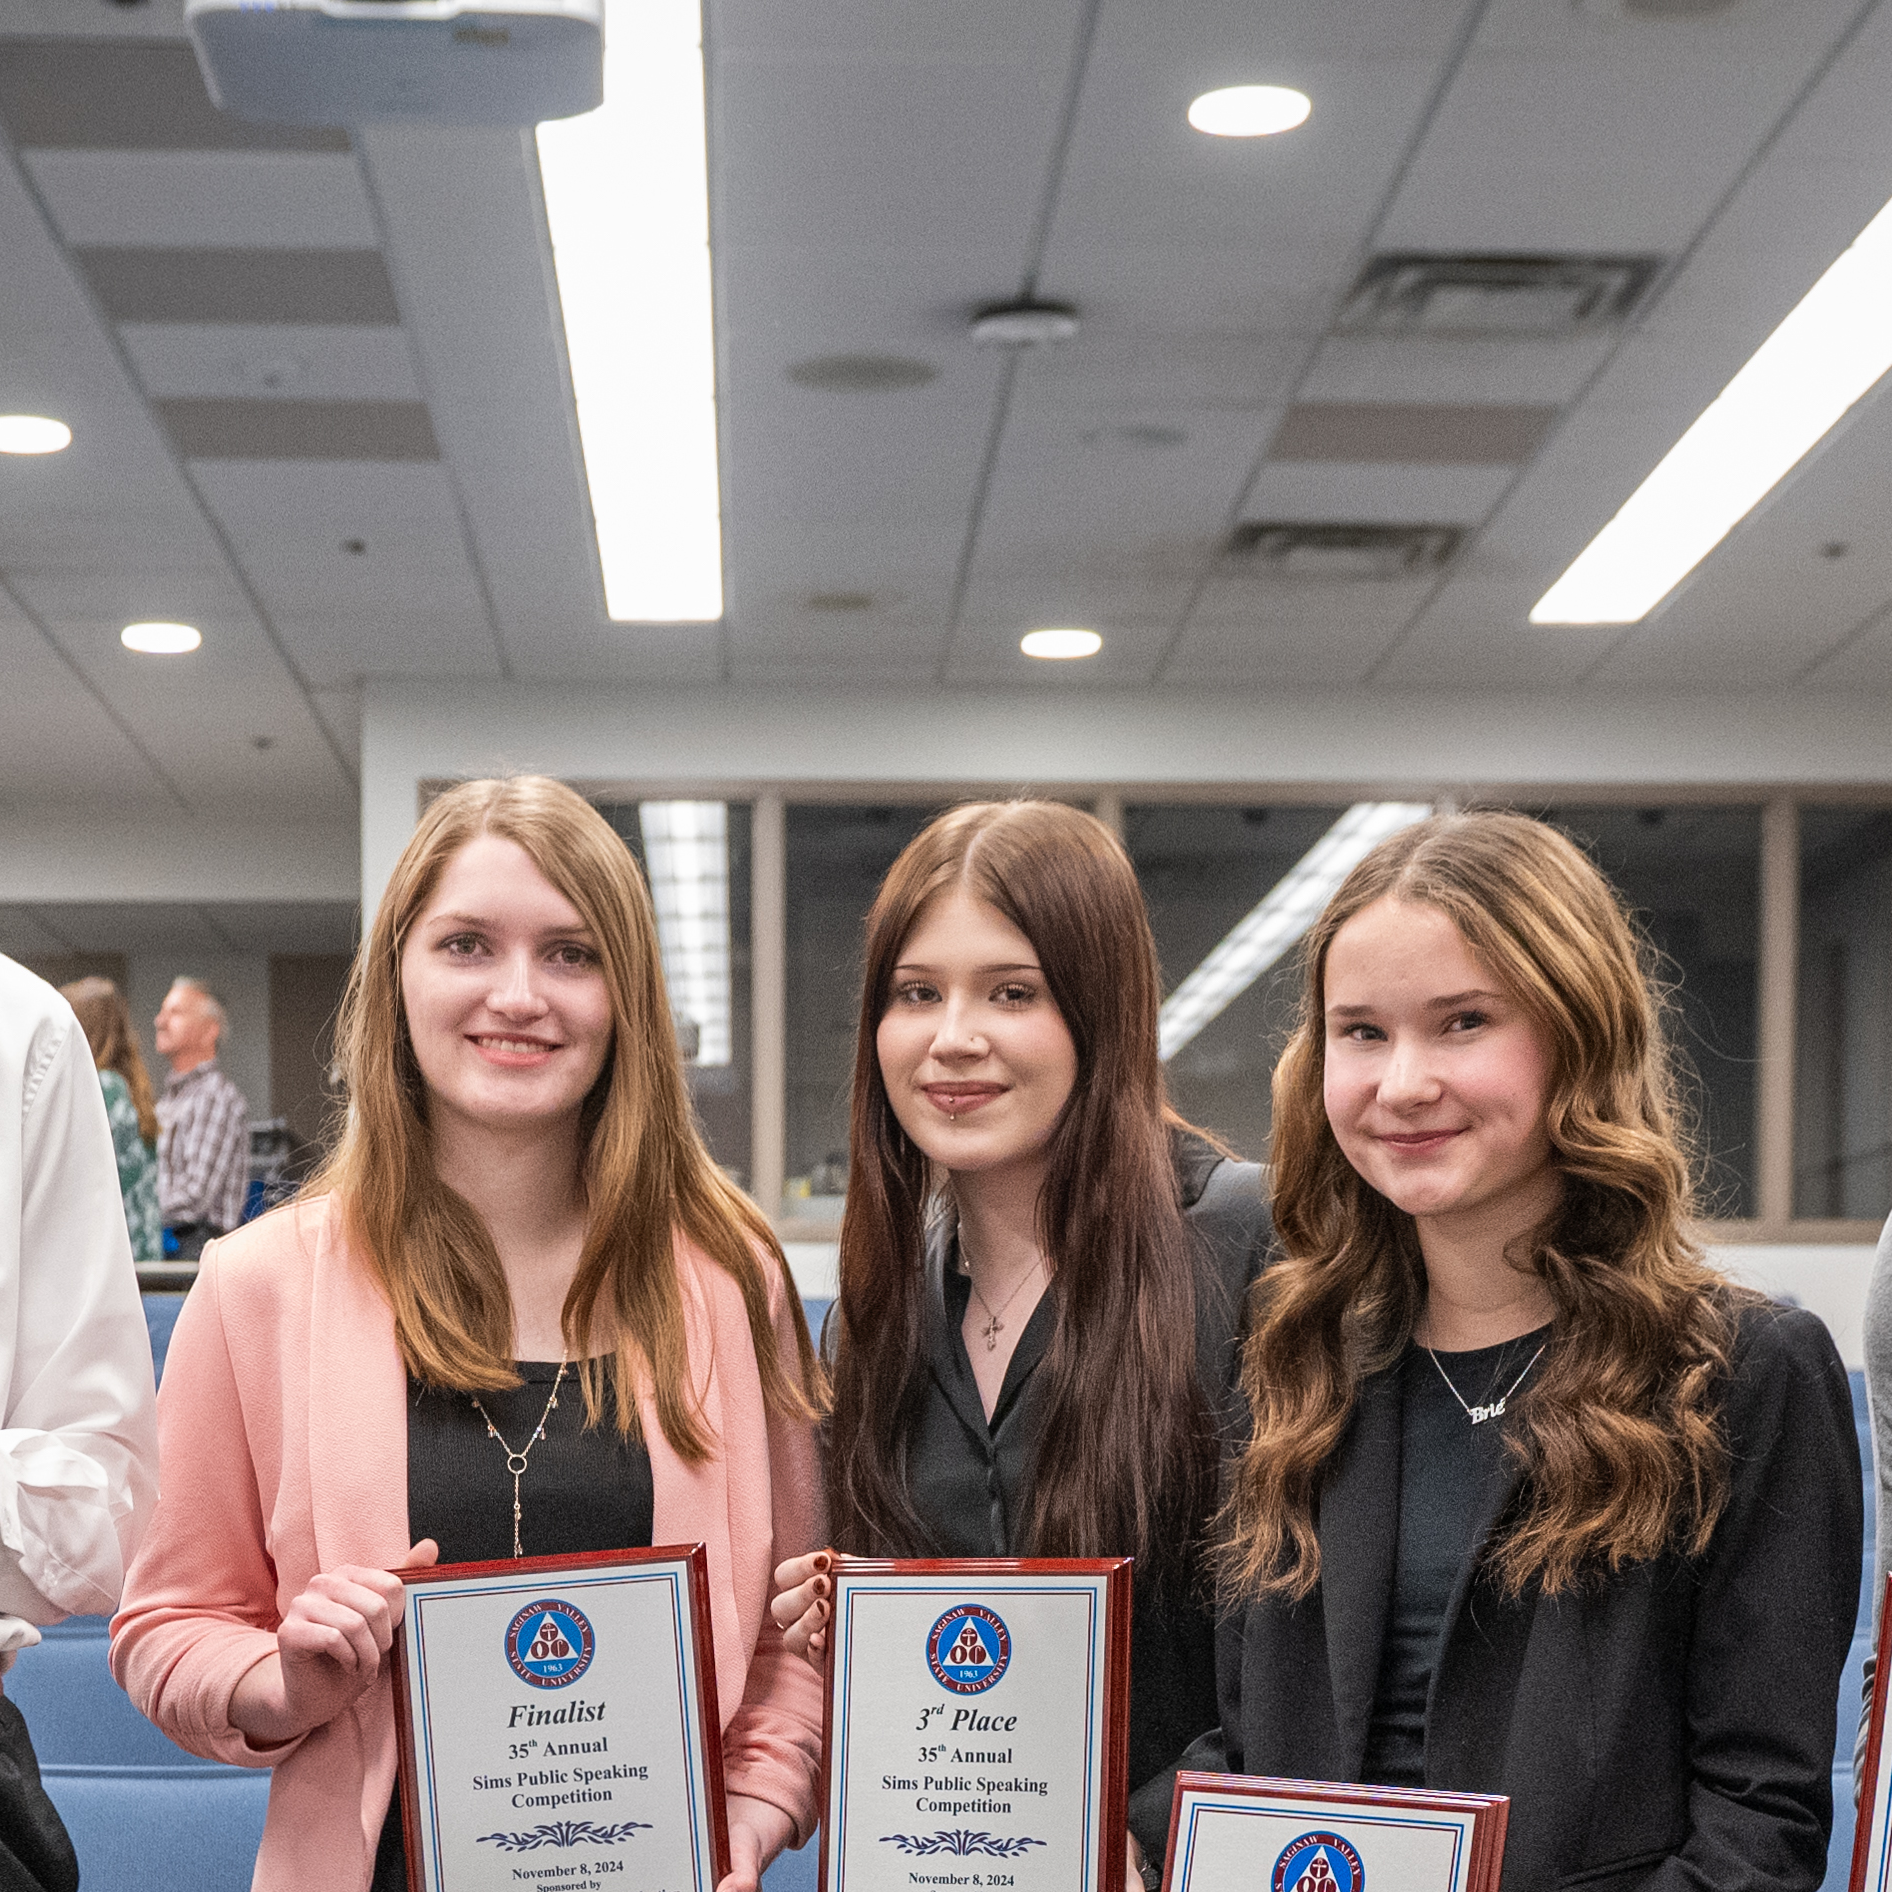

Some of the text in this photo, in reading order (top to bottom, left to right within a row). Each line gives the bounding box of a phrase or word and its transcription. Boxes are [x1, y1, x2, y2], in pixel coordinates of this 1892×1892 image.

[509, 1602, 589, 1638] SAGINAW VALLEY
[931, 1608, 1007, 1641] SAGINAW VALLEY
[510, 1646, 592, 1686] STATE UNIVERSITY
[543, 1664, 563, 1673] 1963
[930, 1653, 1008, 1692] STATE UNIVERSITY
[959, 1670, 978, 1679] 1963
[507, 1699, 606, 1729] Finalist
[915, 1703, 1018, 1732] 3rd Place
[508, 1736, 608, 1760] 35th Annual
[917, 1743, 1013, 1764] 35th Annual
[473, 1763, 649, 1791] Sims Public Speaking
[881, 1775, 1048, 1797] Sims Public Speaking
[511, 1787, 613, 1810] Competition
[915, 1797, 1011, 1817] Competition
[1279, 1835, 1361, 1875] SAGINAW VALLEY
[511, 1860, 624, 1881] November 8, 2024
[909, 1872, 1015, 1887] November 8, 2024
[588, 1879, 602, 1891] by
